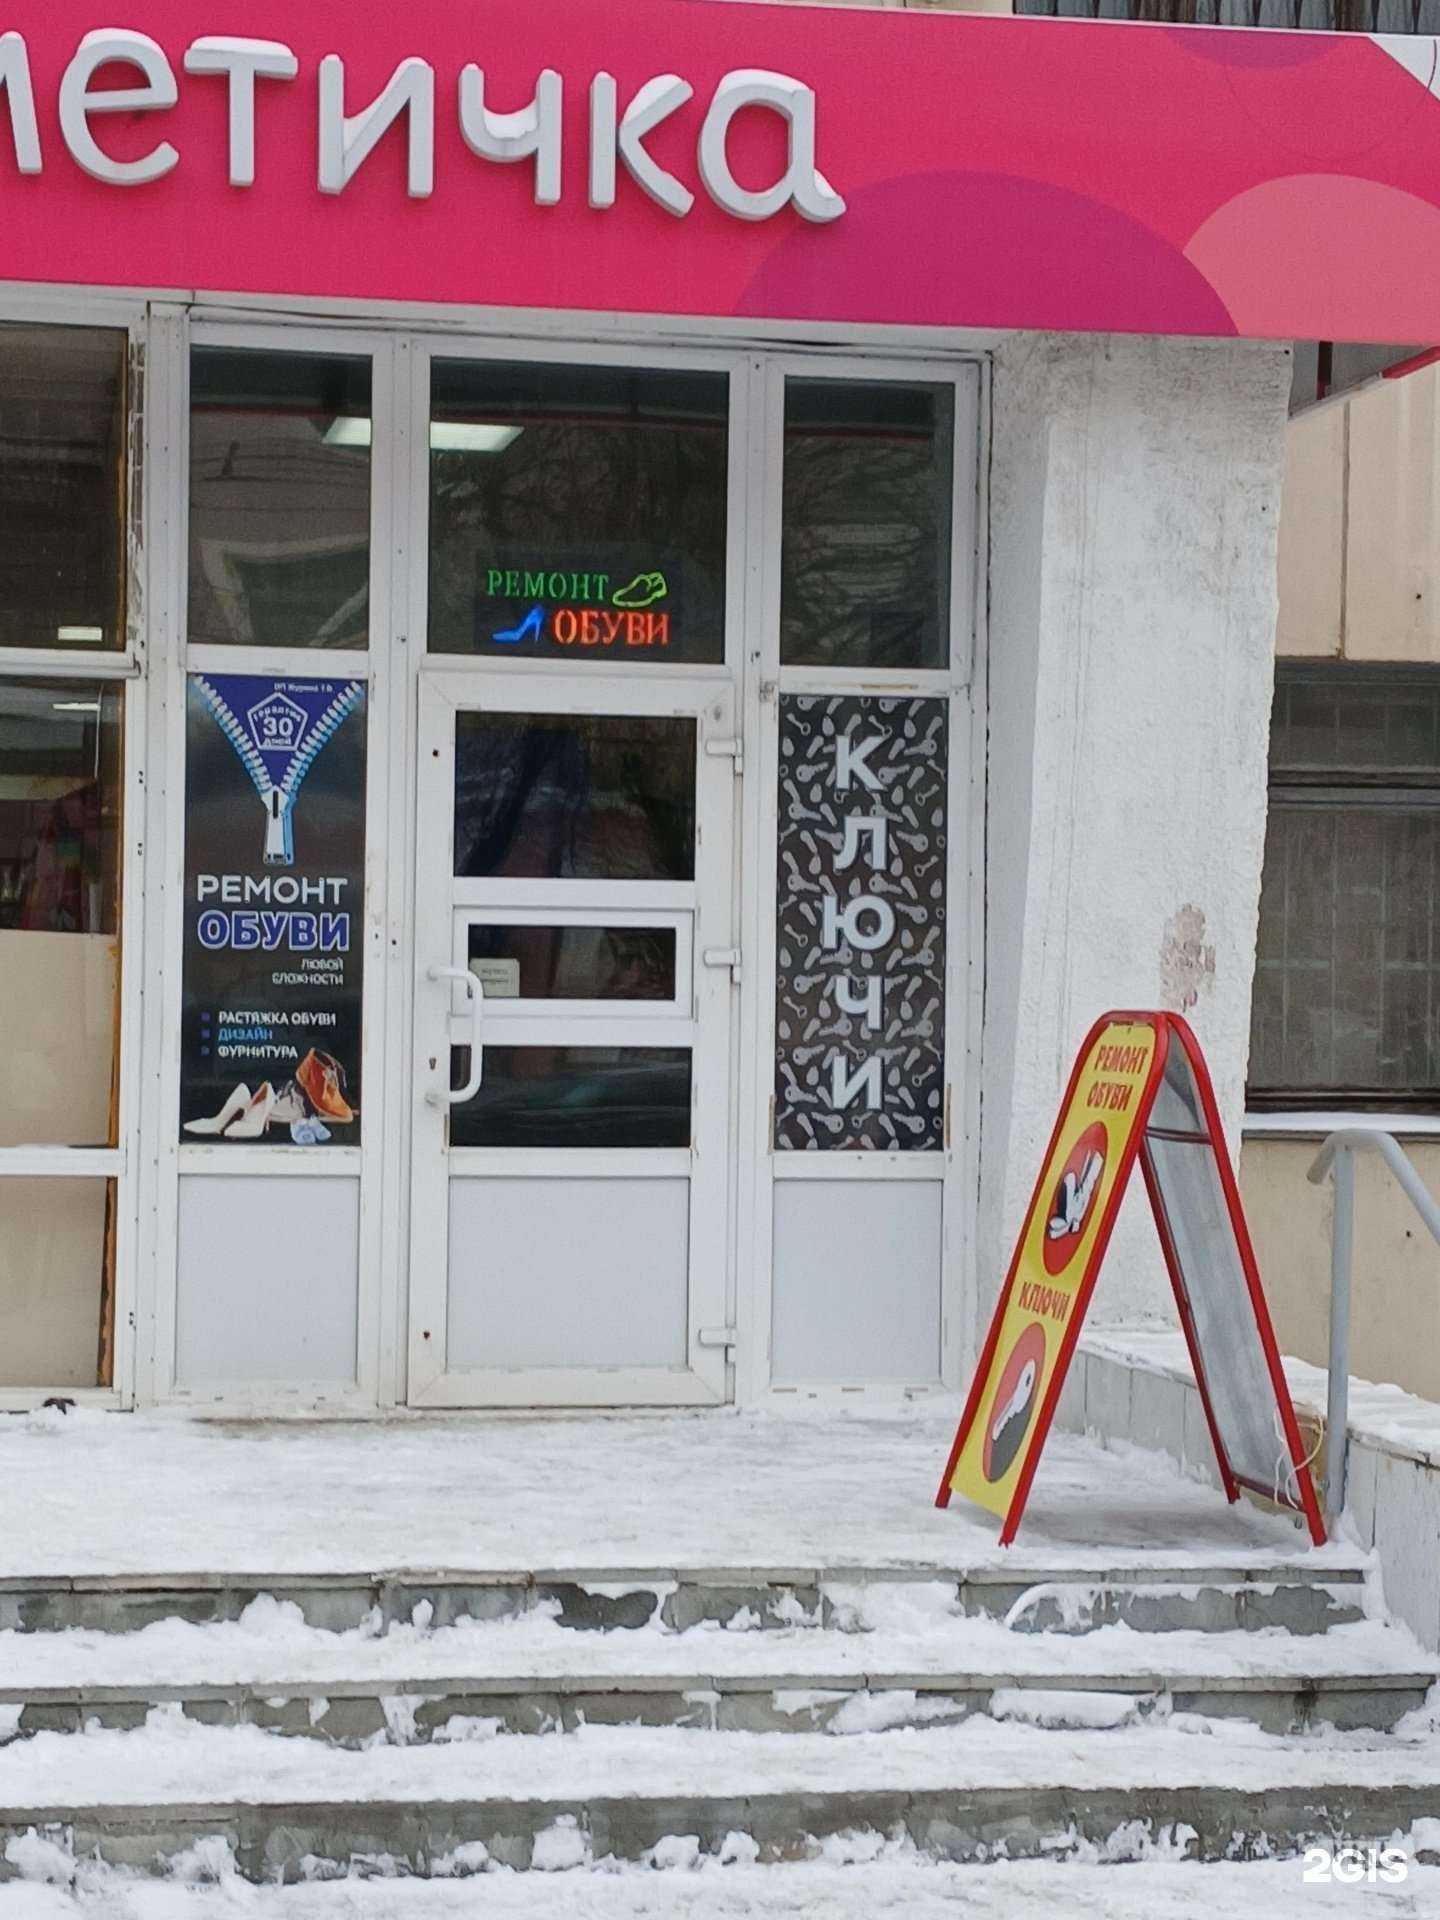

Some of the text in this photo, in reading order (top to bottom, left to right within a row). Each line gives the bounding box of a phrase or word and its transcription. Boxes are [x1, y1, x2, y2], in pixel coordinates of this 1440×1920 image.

[487, 569, 609, 600] РЕМОНТ
[553, 608, 670, 645] ОБУВИ
[263, 717, 294, 737] 30
[197, 874, 348, 905] РЕМОНТ
[197, 910, 351, 952] ОБУВИ
[822, 735, 895, 1110] КЛЮЧИ
[272, 972, 344, 985] СЛОЖНОСТИ
[301, 957, 344, 971] ЛЮБОЙ
[218, 1011, 336, 1026] РАСТЯЖКА ОБУВИ
[218, 1027, 273, 1041] ДИЗАЙН
[217, 1045, 299, 1059] ФУРНИТУРА
[1093, 1045, 1149, 1075] РЕМОНТ
[1086, 1080, 1134, 1111] ОБУВИ
[1018, 1281, 1071, 1322] КЛЮЧИ
